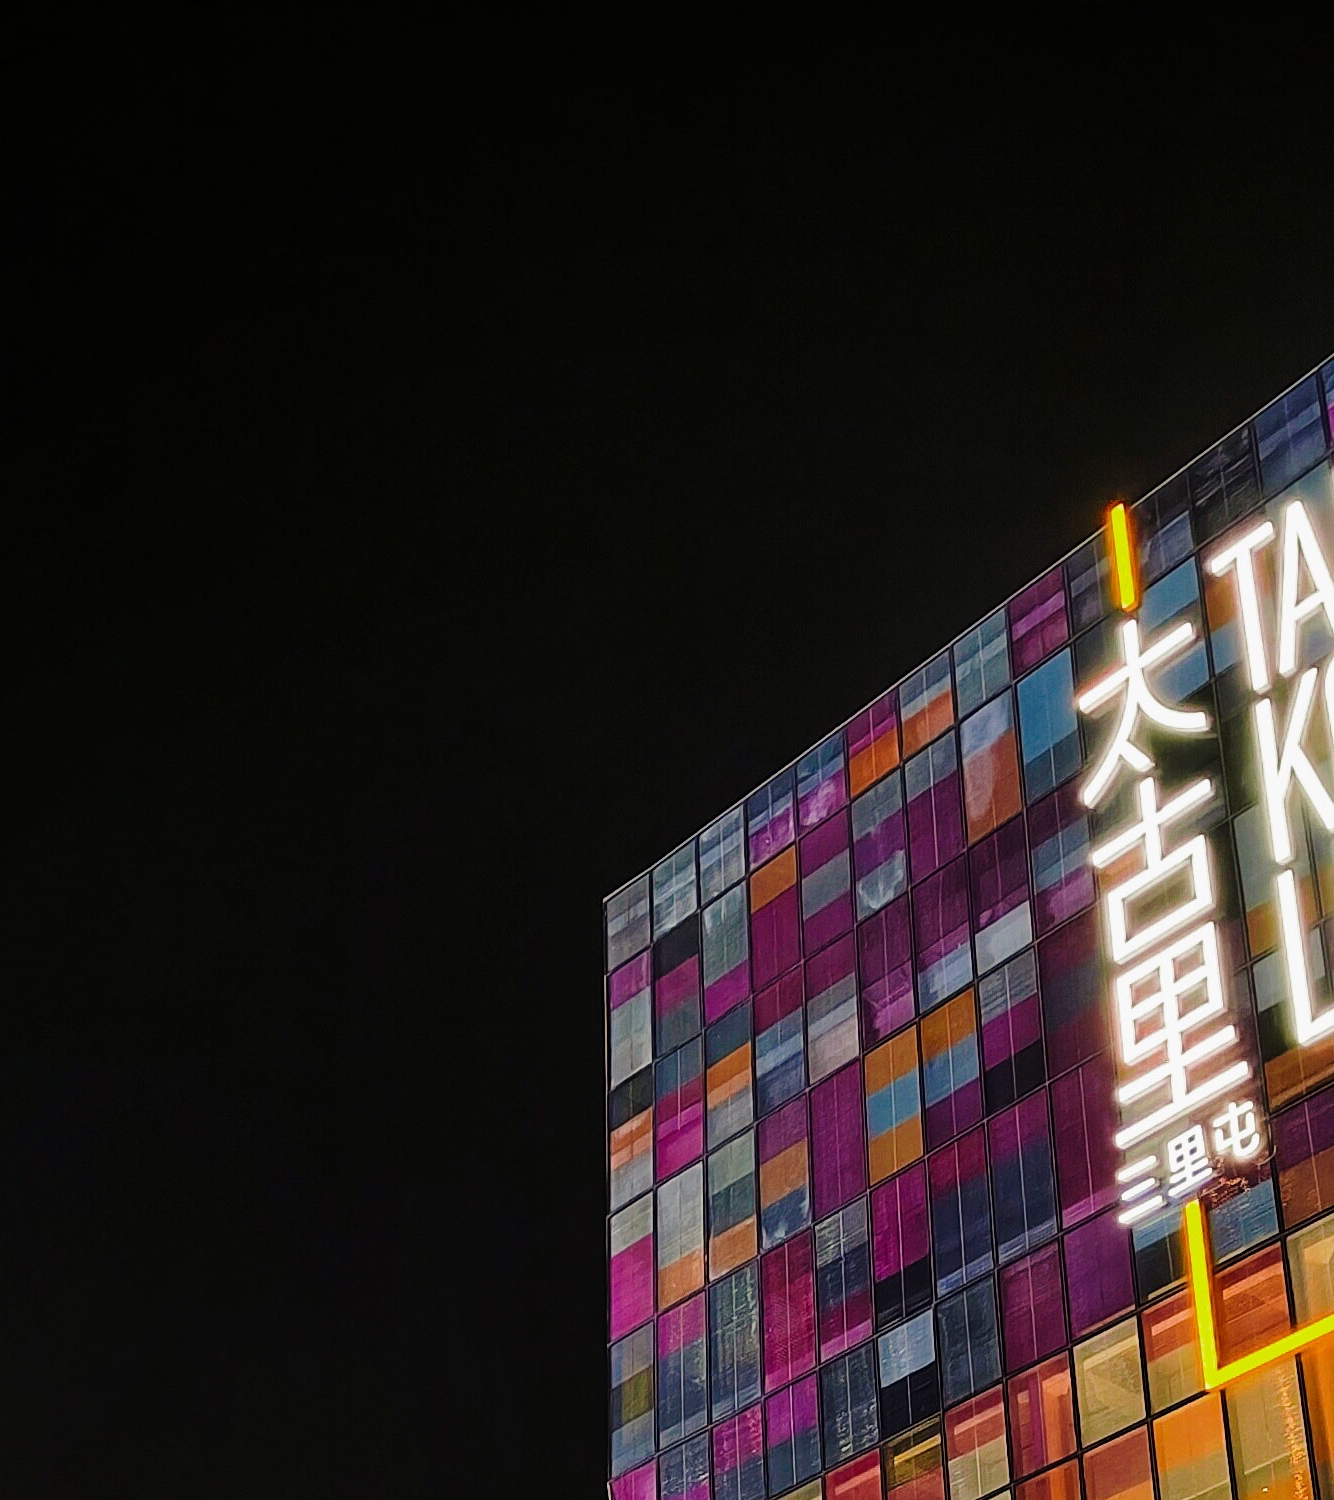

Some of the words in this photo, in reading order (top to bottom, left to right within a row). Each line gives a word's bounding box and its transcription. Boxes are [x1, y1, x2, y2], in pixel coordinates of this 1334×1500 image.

[1076, 618, 1249, 1149] 太古里
[1117, 1100, 1261, 1225] 三里屯
